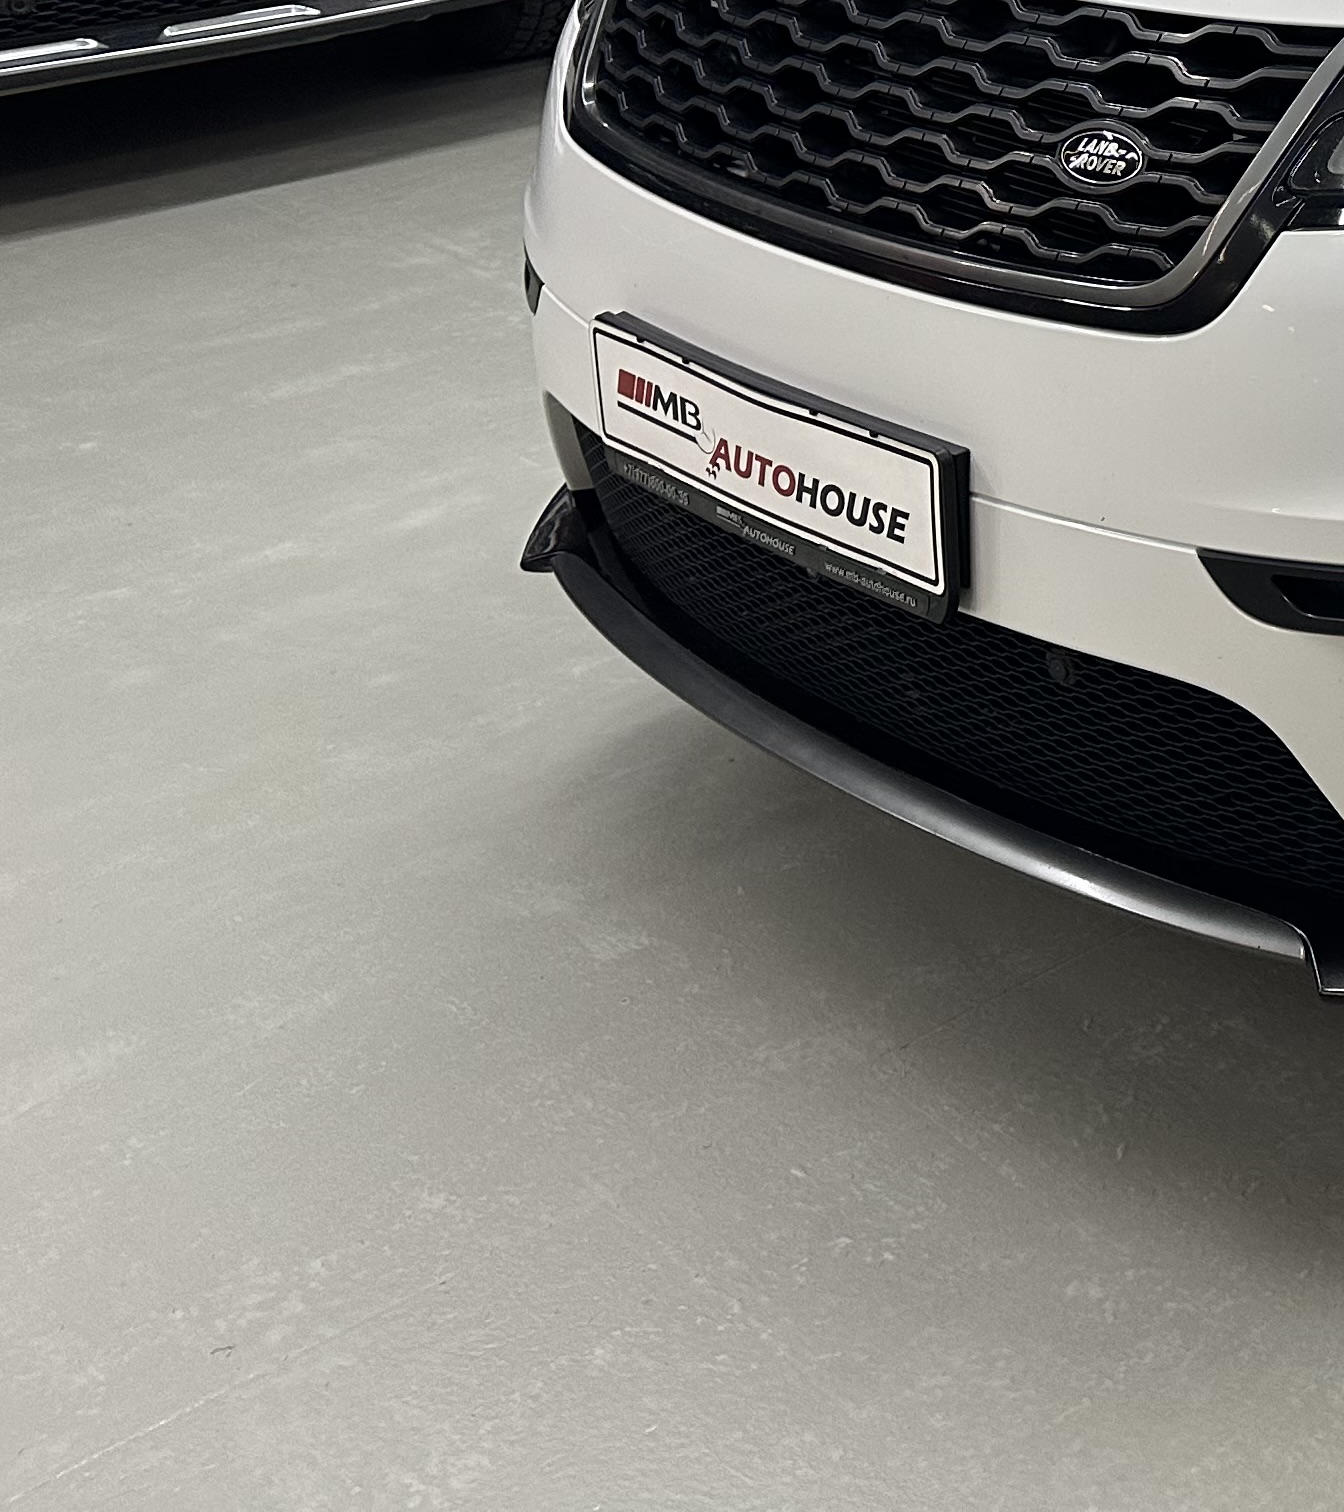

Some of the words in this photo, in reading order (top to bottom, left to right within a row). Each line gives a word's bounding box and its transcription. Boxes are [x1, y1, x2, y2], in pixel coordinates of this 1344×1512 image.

[1074, 152, 1127, 177] ROVER
[708, 436, 912, 545] AUTOHOUSE
[742, 524, 796, 557] AUTOHOUSE
